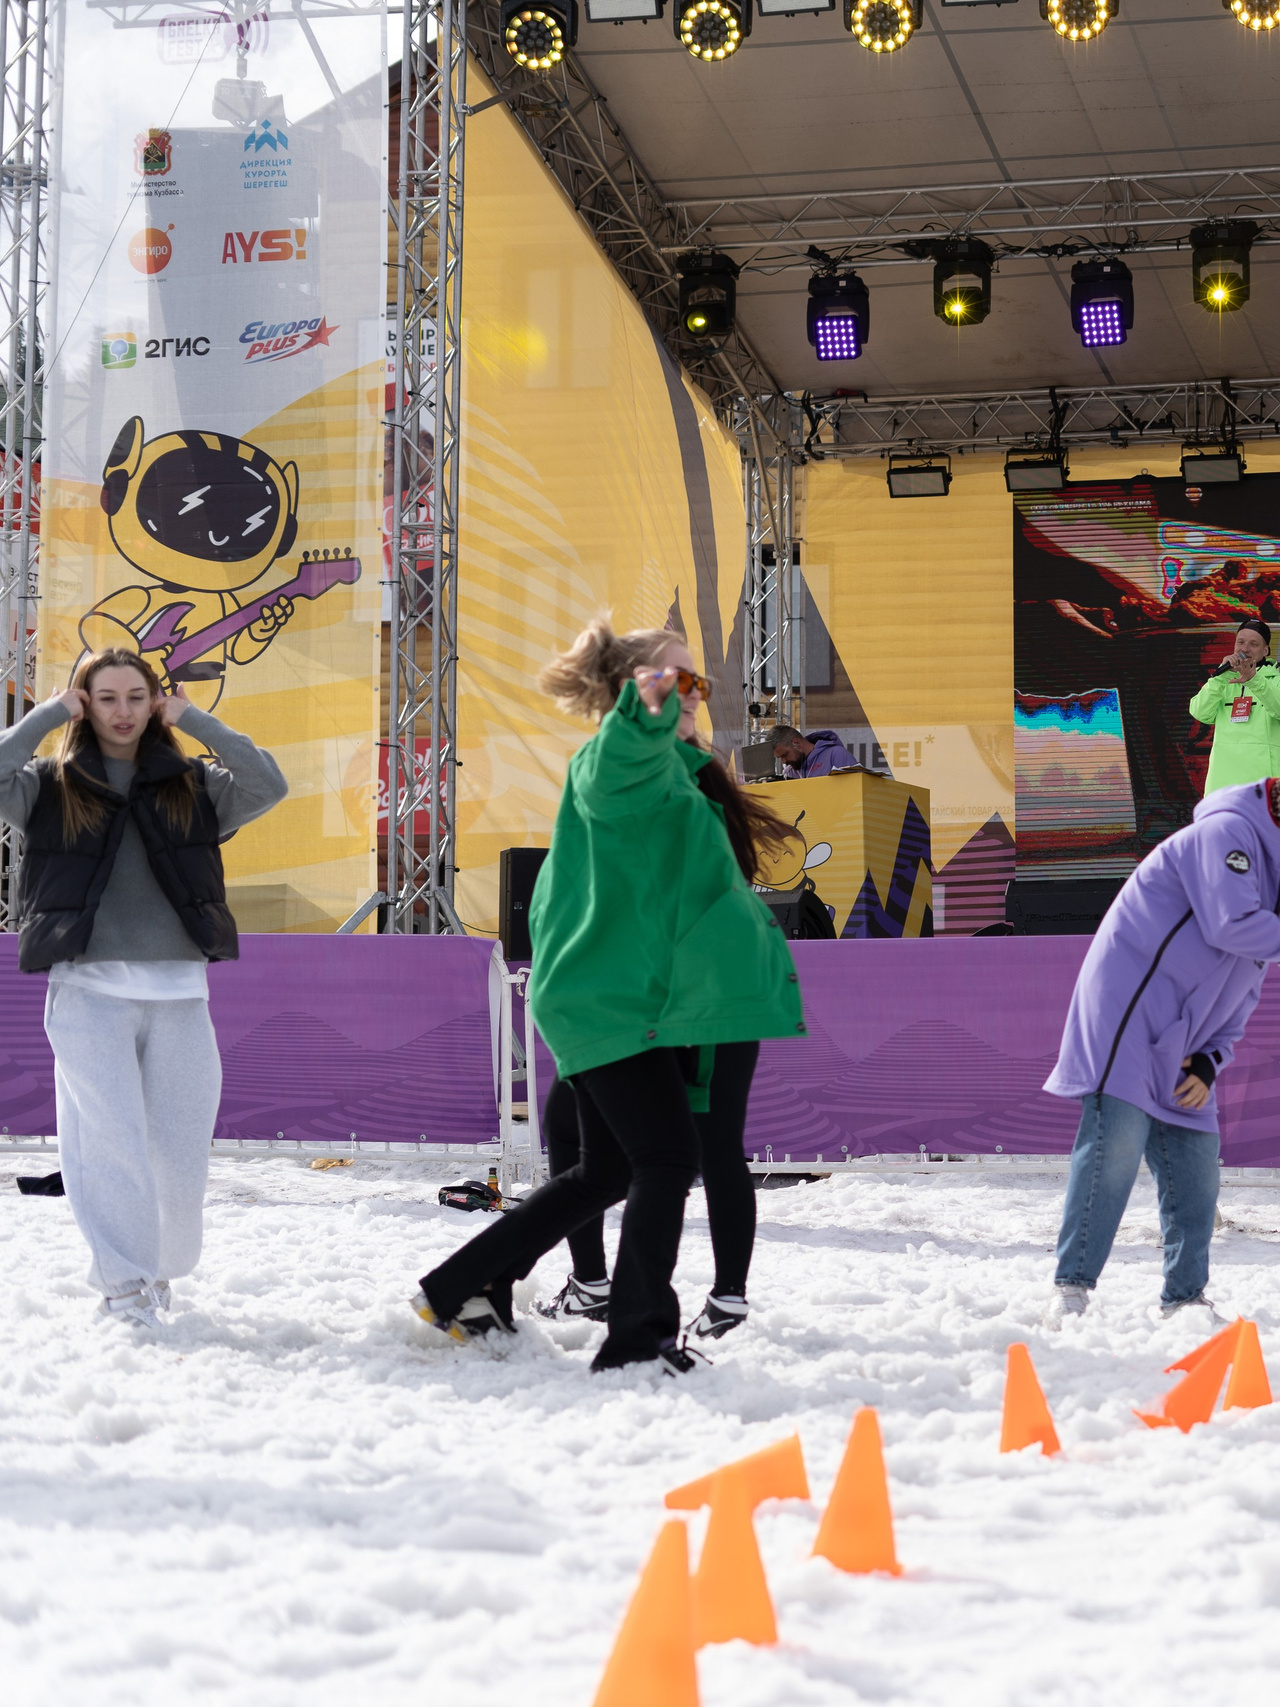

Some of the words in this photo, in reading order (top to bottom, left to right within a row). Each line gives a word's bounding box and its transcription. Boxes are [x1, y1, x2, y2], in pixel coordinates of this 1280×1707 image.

[240, 158, 292, 169] ДИРЕКЦИЯ
[244, 170, 287, 178] КУРОРТА
[131, 180, 177, 189] Министерство
[243, 180, 288, 189] ШЕРЕГЕШ
[153, 188, 184, 198] Кузбасса
[221, 229, 306, 264] AYS!
[144, 336, 211, 358] 2ГИС
